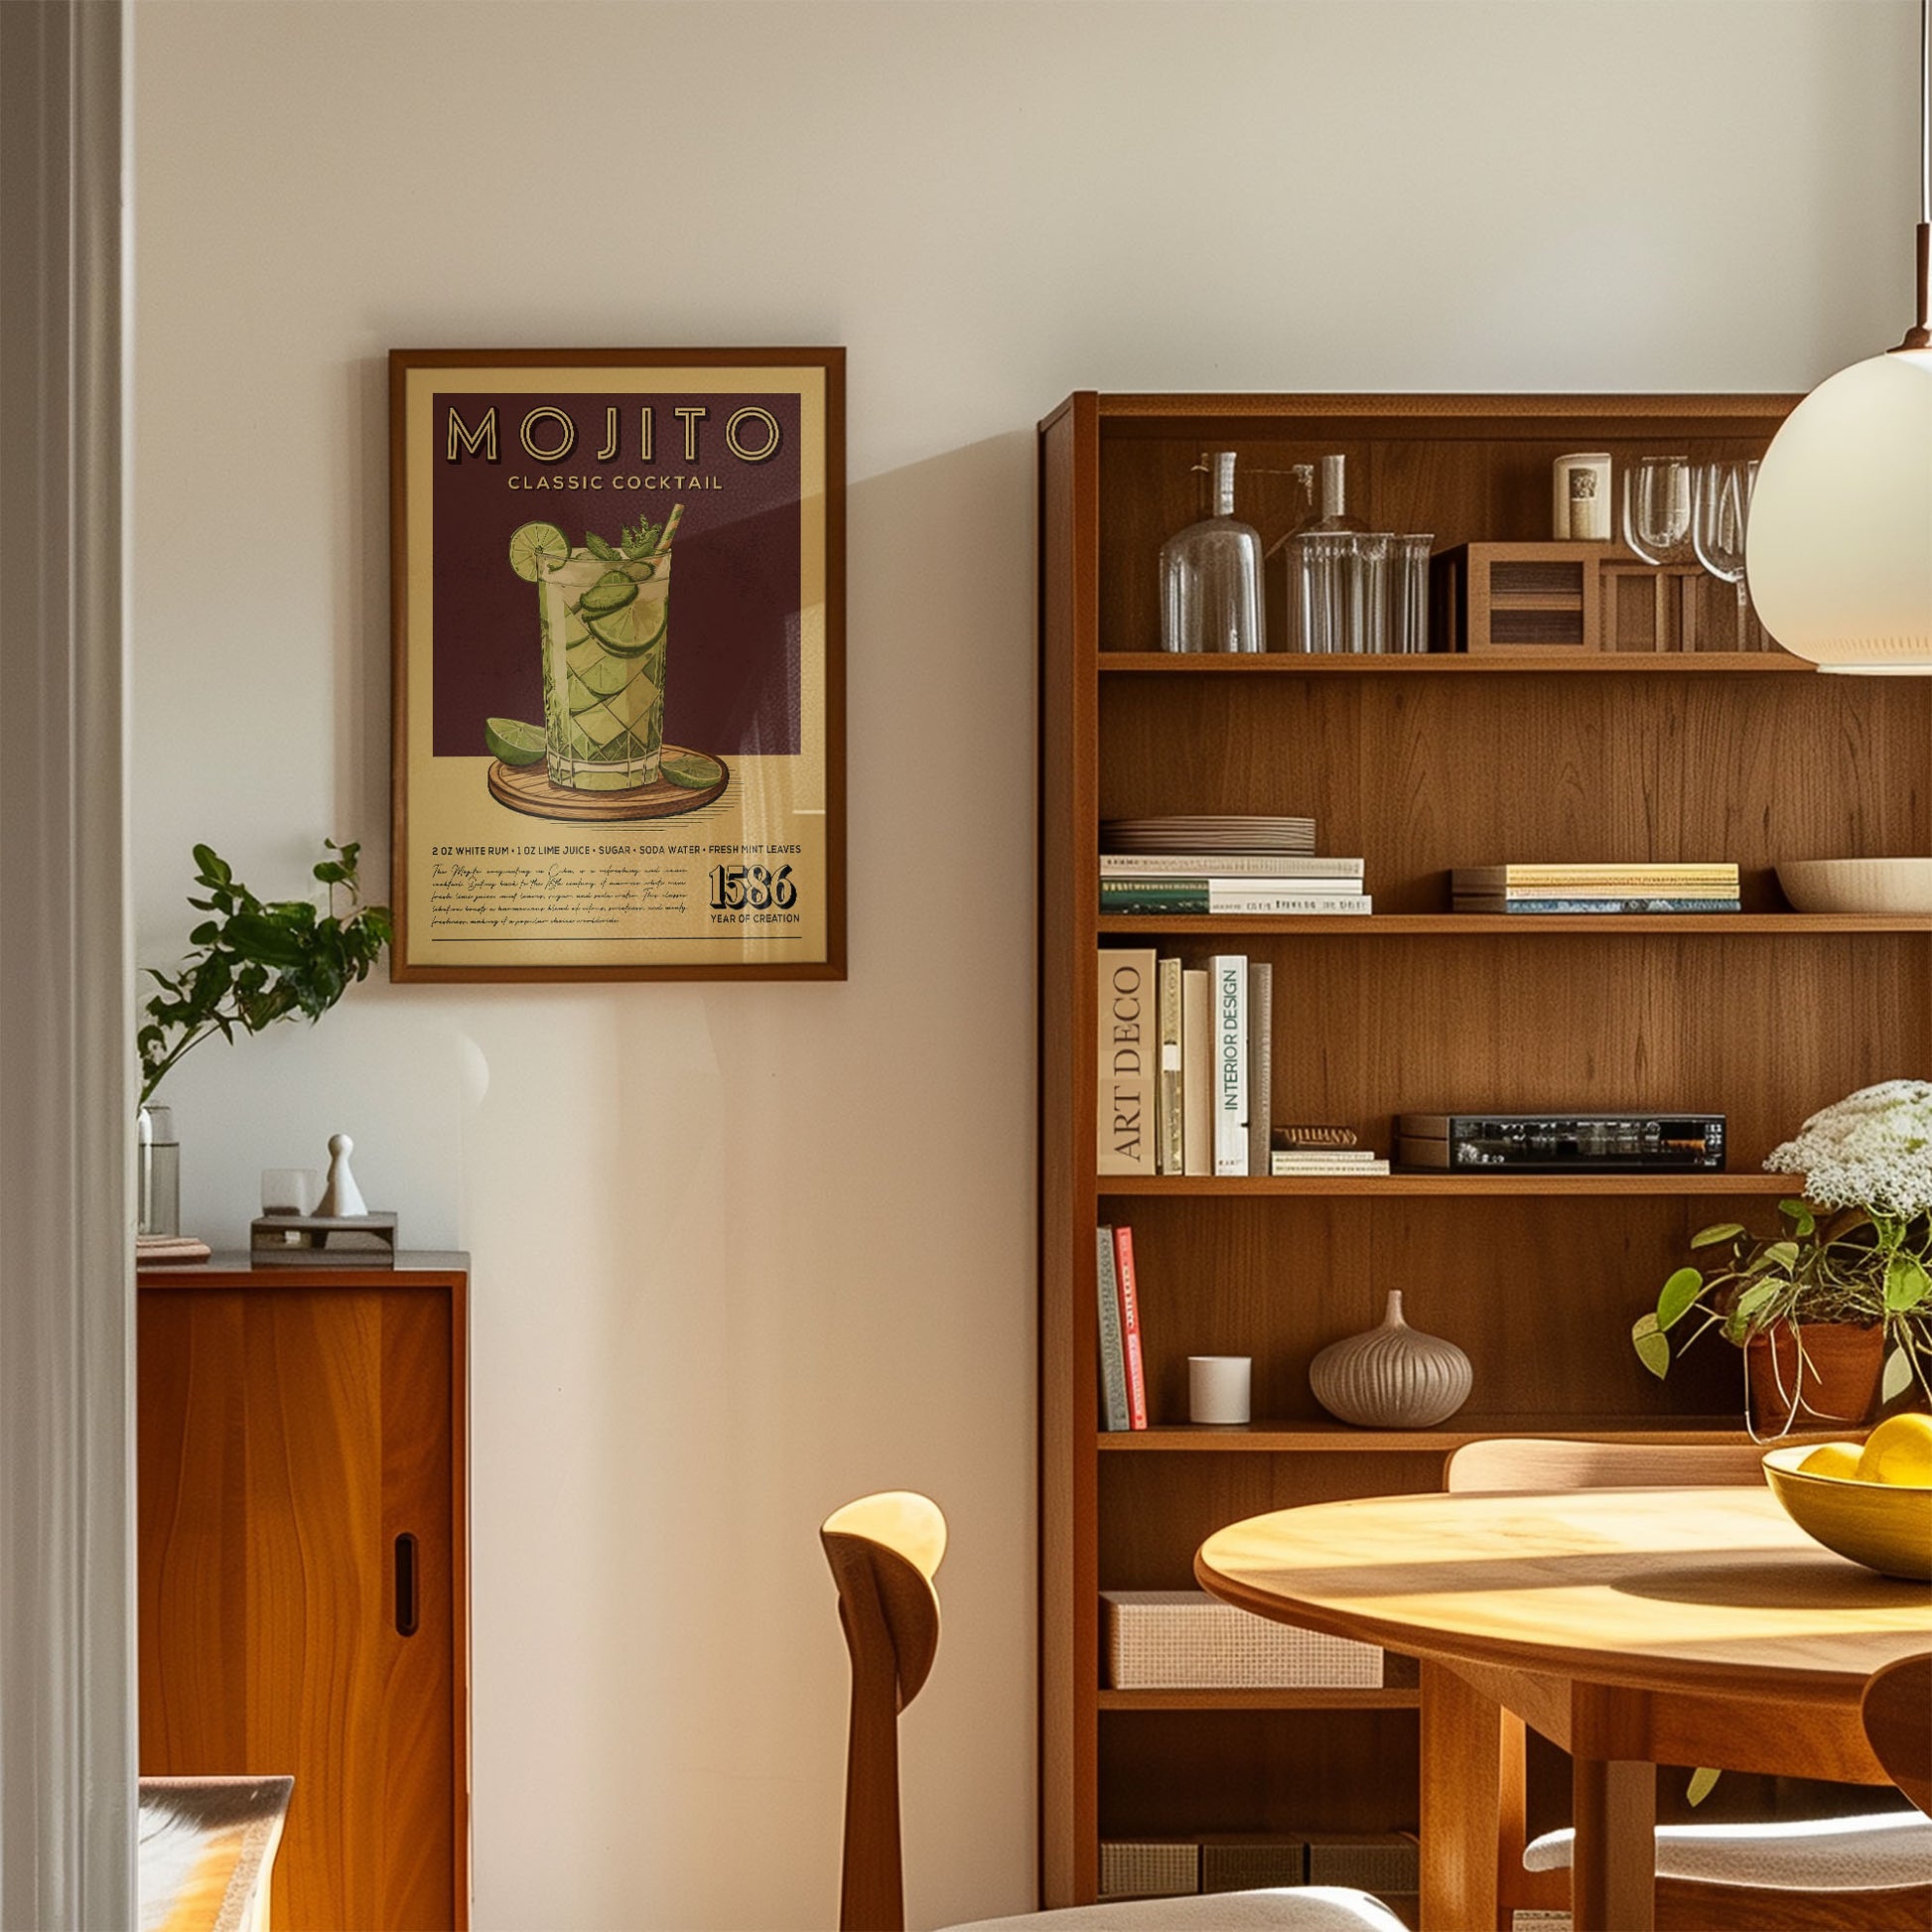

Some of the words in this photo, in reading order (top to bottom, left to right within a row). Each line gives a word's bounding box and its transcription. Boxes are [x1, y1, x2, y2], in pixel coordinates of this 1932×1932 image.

[446, 405, 783, 465] MOJITO
[507, 475, 604, 491] CLASSIC
[612, 475, 725, 491] COCKTAIL
[432, 846, 439, 856] 2
[440, 846, 454, 856] OZ
[455, 846, 486, 856] WHITE
[487, 846, 509, 856] RUM
[516, 846, 522, 856] 1
[522, 846, 536, 856] OZ
[538, 846, 561, 855] LIME
[562, 845, 591, 855] JUICE
[598, 845, 631, 855] SUGAR
[638, 845, 665, 855] SODA
[667, 845, 701, 854] WATER
[708, 845, 740, 854] FRESH
[741, 845, 764, 854] MINT
[765, 844, 802, 854] LEAVES
[708, 864, 798, 910] 1586
[710, 913, 737, 923] YEAR
[738, 913, 751, 923] OF
[753, 913, 801, 923] CREATION
[1112, 965, 1142, 1078] DECO
[1222, 969, 1238, 1031] DESIGN
[1223, 1034, 1238, 1111] INTERIOR
[1113, 1085, 1142, 1163] ART
